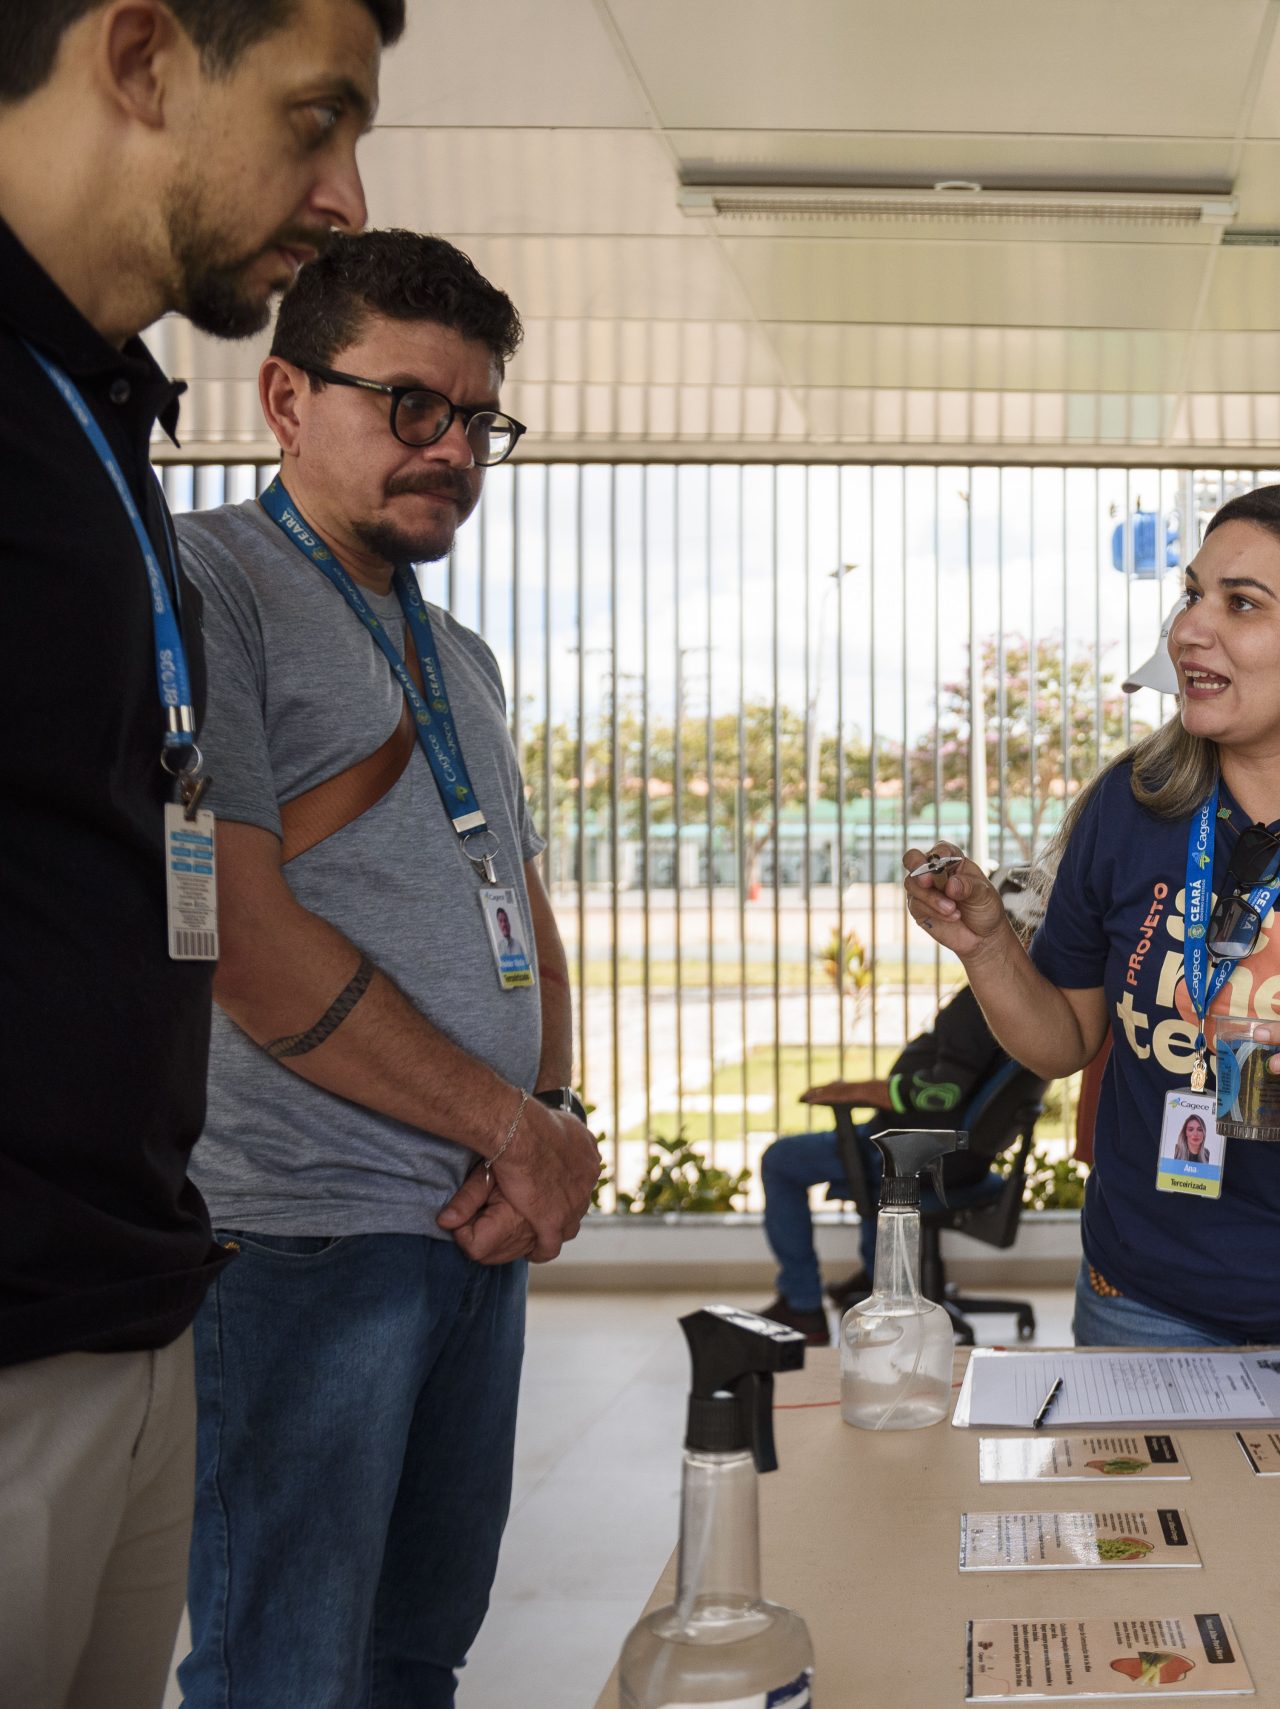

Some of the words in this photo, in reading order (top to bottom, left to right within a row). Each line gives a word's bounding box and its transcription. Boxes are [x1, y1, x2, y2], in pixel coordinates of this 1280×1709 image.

[422, 656, 442, 697] CEARÁ
[1197, 805, 1210, 851] Cagece
[1189, 880, 1202, 922] CEARÁ
[1126, 881, 1169, 987] PROJETO
[1192, 948, 1202, 999] Cagece
[1180, 1100, 1210, 1111] Cagece
[1170, 1178, 1207, 1191] Terceirizada
[1183, 1164, 1197, 1173] Ana
